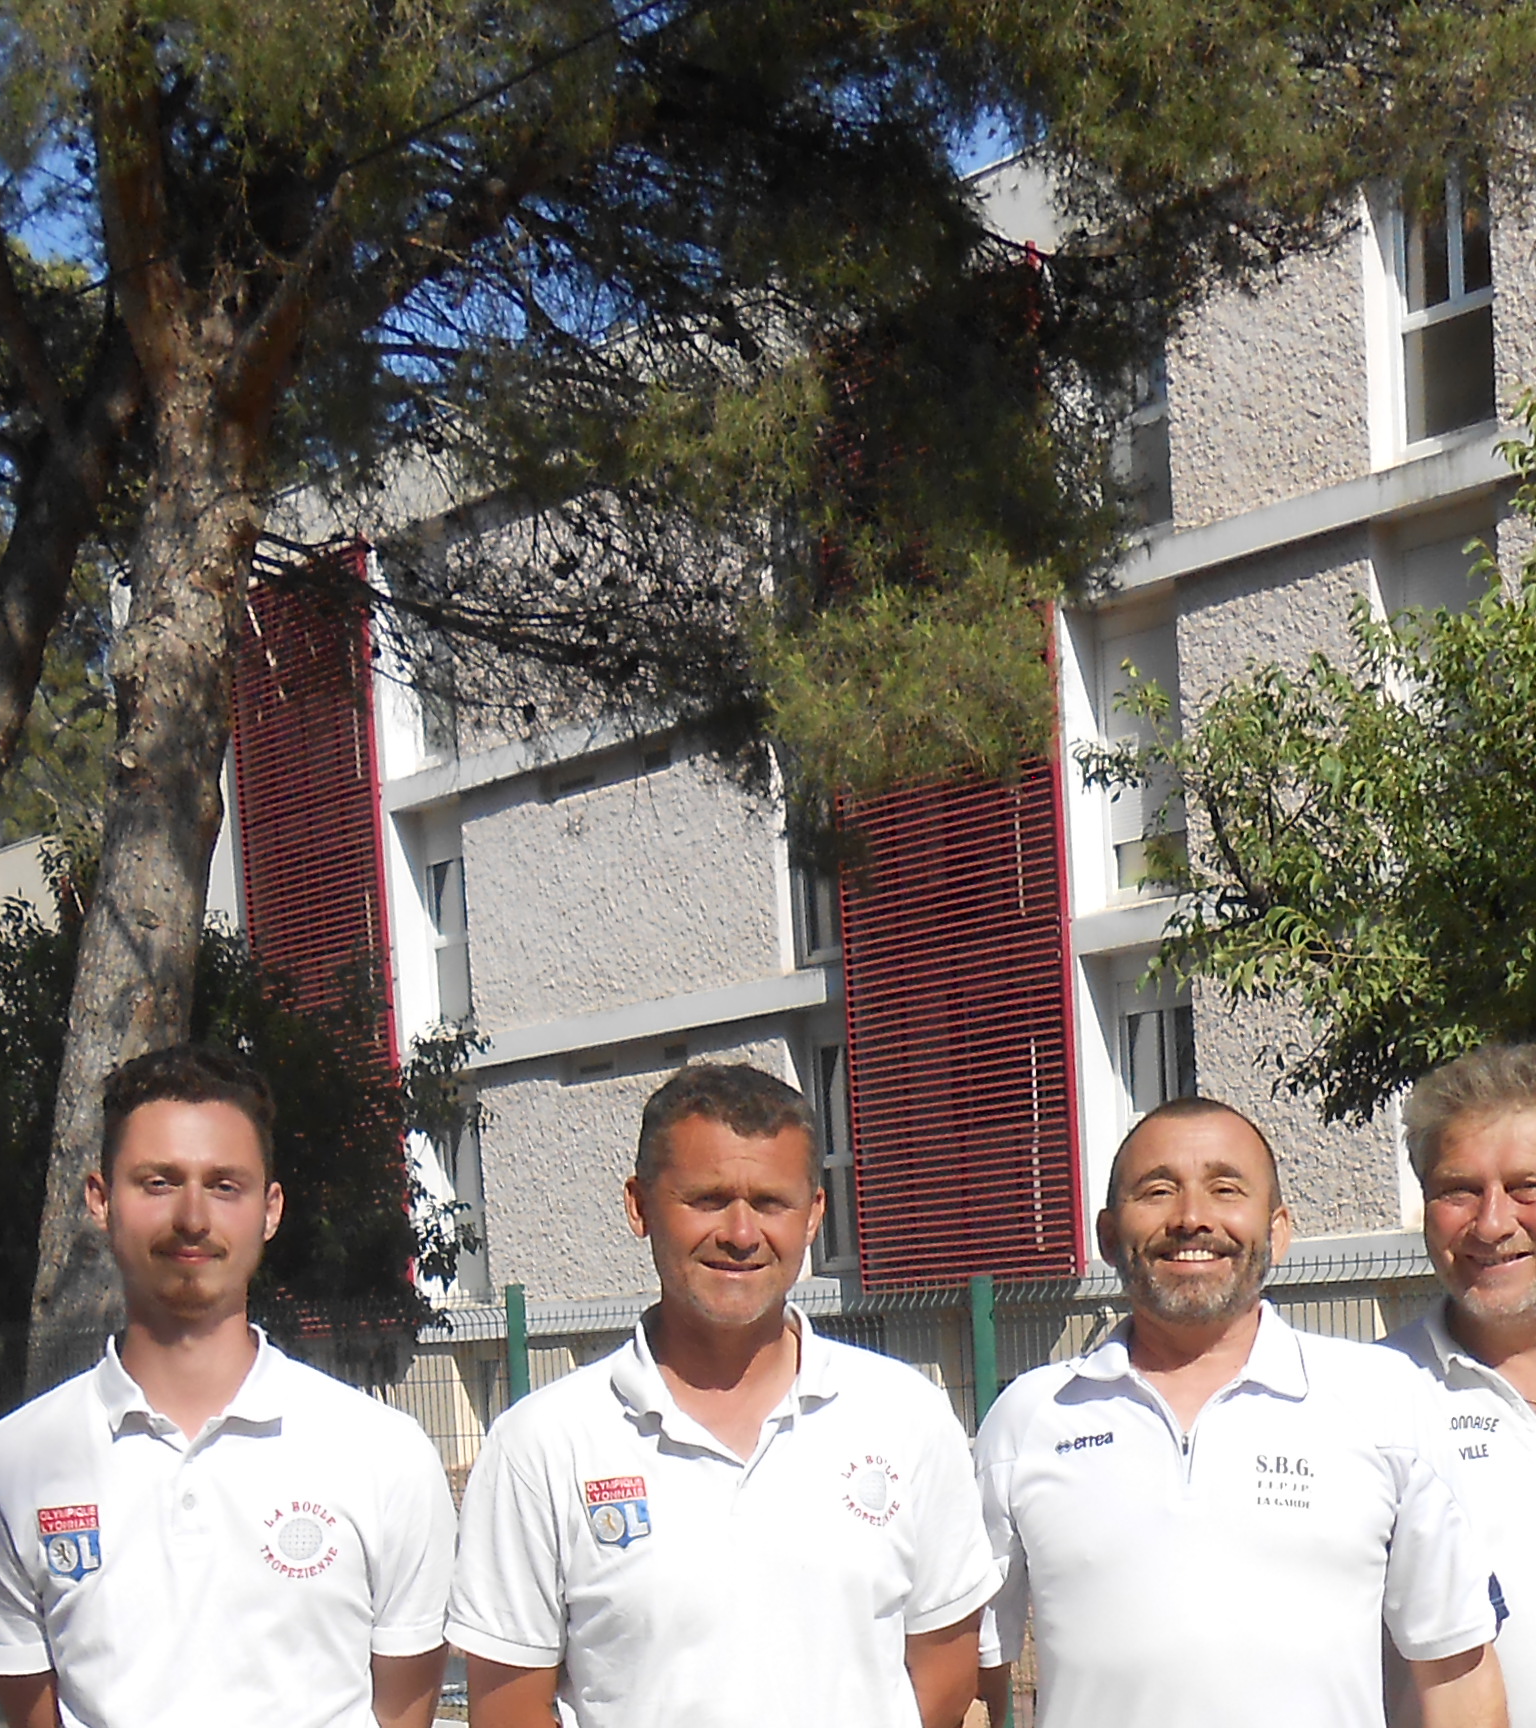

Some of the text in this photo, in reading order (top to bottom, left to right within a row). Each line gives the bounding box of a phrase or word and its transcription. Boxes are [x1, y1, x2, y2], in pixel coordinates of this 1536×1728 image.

[1255, 1454, 1314, 1478] S.B.G.
[263, 1500, 337, 1528] LA BOULE
[260, 1544, 338, 1579] TROPEZIENNE
